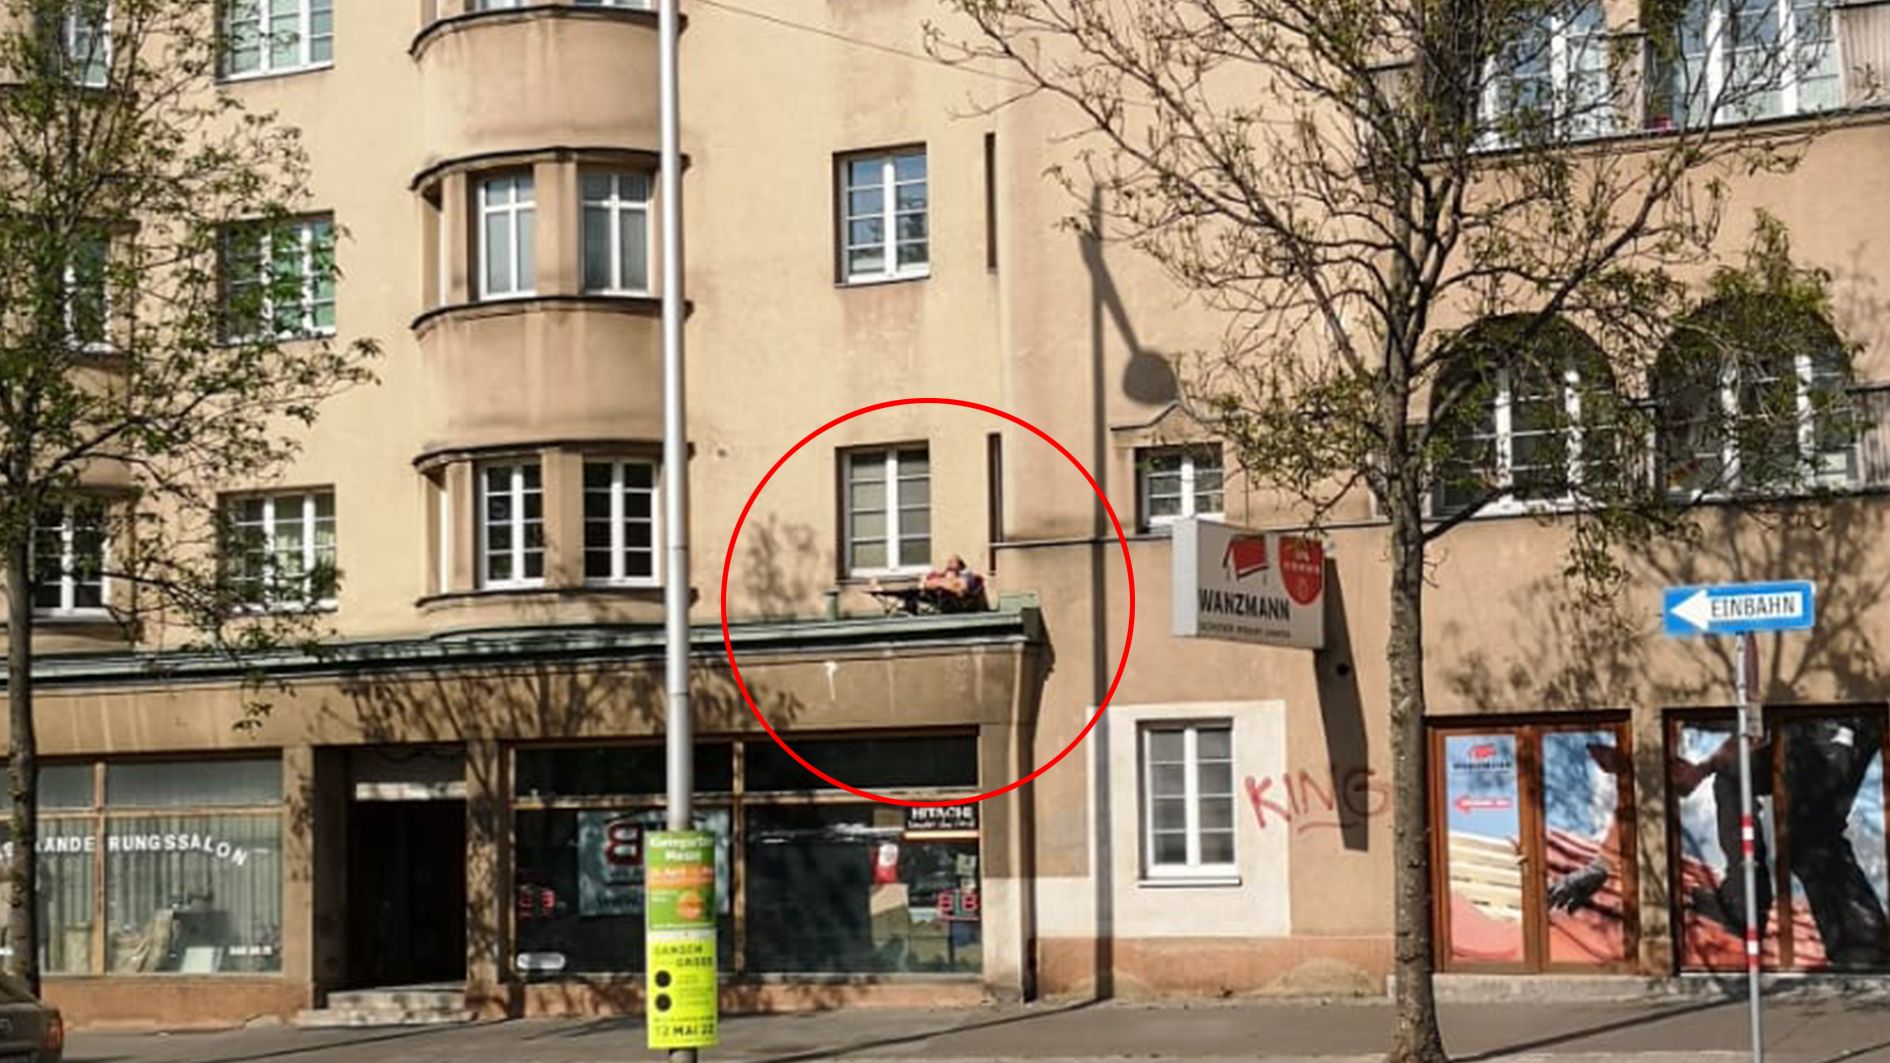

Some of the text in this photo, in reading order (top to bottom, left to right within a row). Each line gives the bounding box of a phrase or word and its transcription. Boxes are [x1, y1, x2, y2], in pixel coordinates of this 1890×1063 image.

[1198, 588, 1290, 621] WANZMANN
[1711, 595, 1796, 618] EINBAHN
[1244, 767, 1392, 829] KING
